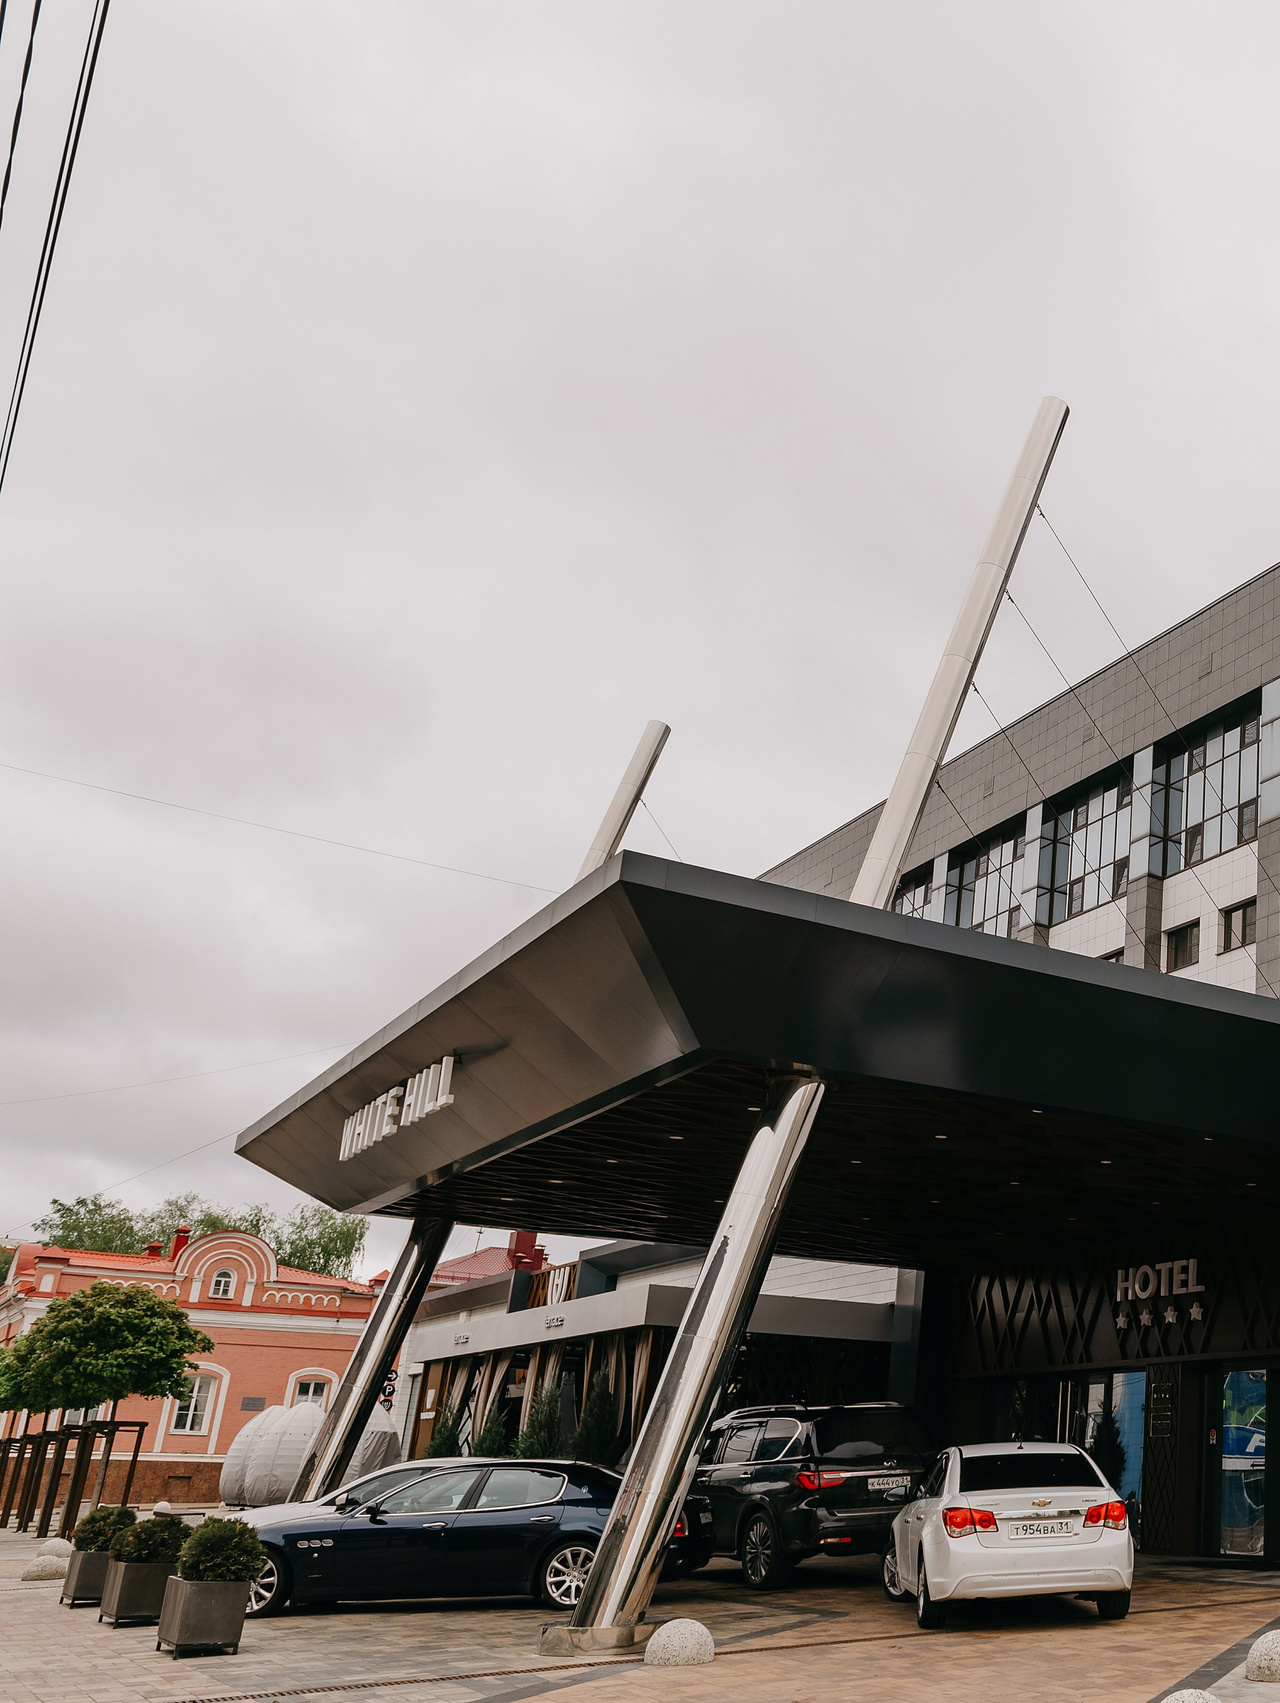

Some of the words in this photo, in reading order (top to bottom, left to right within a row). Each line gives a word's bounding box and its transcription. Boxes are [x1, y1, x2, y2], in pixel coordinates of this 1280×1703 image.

[339, 1086, 404, 1161] WHITE
[400, 1056, 454, 1126] HILL
[1117, 1258, 1205, 1302] HOTEL
[386, 1385, 393, 1396] P
[1015, 1523, 1055, 1535] Т954ВА
[1058, 1522, 1070, 1531] 31
